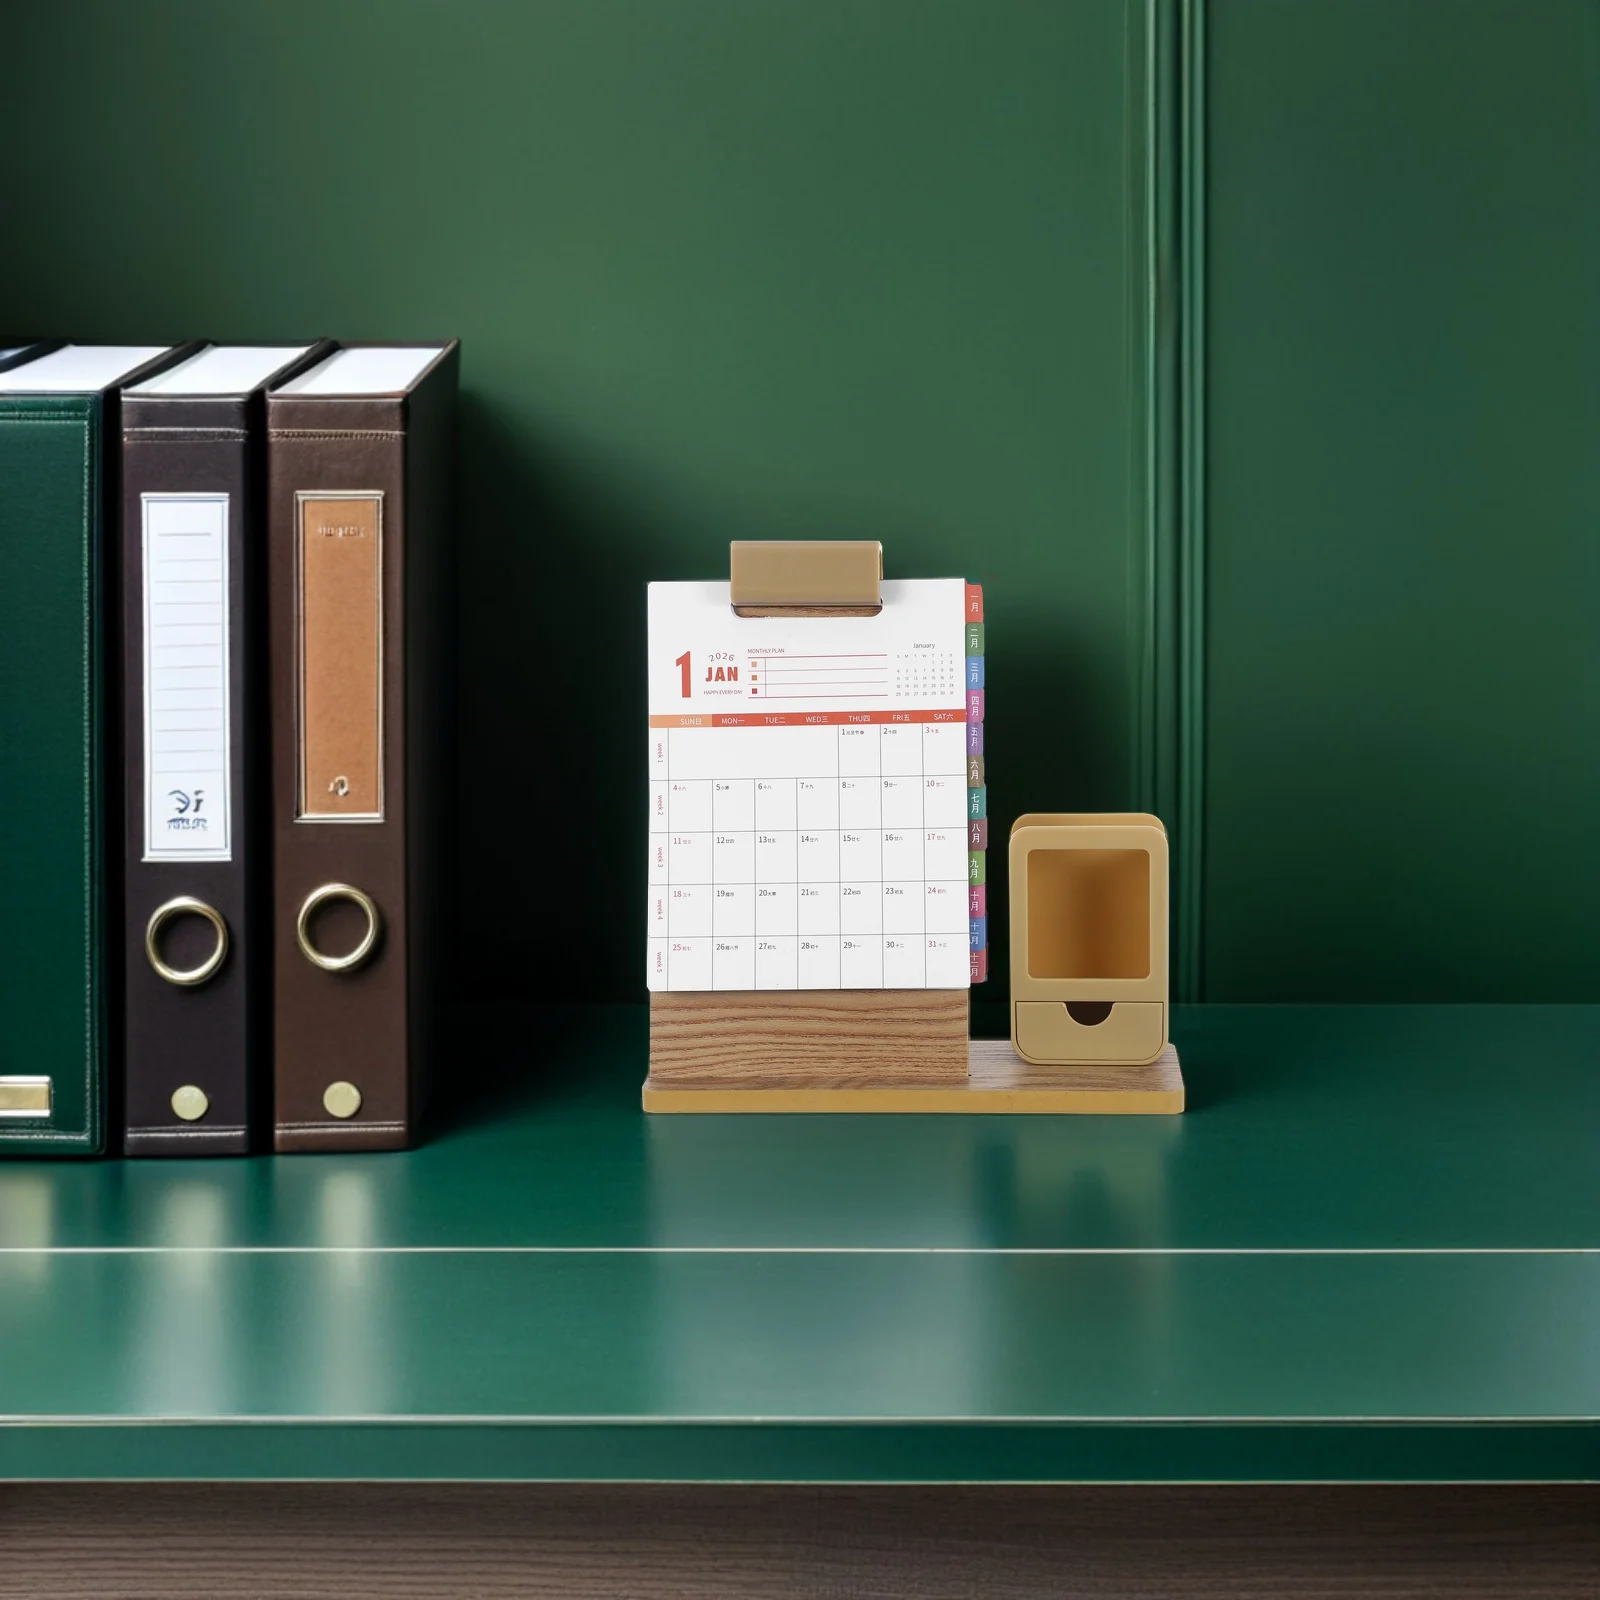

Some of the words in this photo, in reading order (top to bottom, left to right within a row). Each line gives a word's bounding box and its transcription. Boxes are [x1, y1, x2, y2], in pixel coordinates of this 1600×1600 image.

[970, 595, 979, 612] 一月
[970, 628, 979, 648] 二月
[708, 652, 735, 662] 2026
[676, 651, 691, 698] 1
[705, 666, 739, 682] JAN
[970, 662, 979, 683] 三月
[971, 696, 979, 716] 四月
[971, 727, 978, 747] 五月
[970, 760, 978, 780] 六月
[971, 793, 979, 813] 七月
[971, 824, 980, 843] 八月
[969, 858, 979, 878] 九月
[970, 891, 979, 911] 十月
[970, 922, 979, 945] 十一月
[970, 953, 979, 976] 十二月
